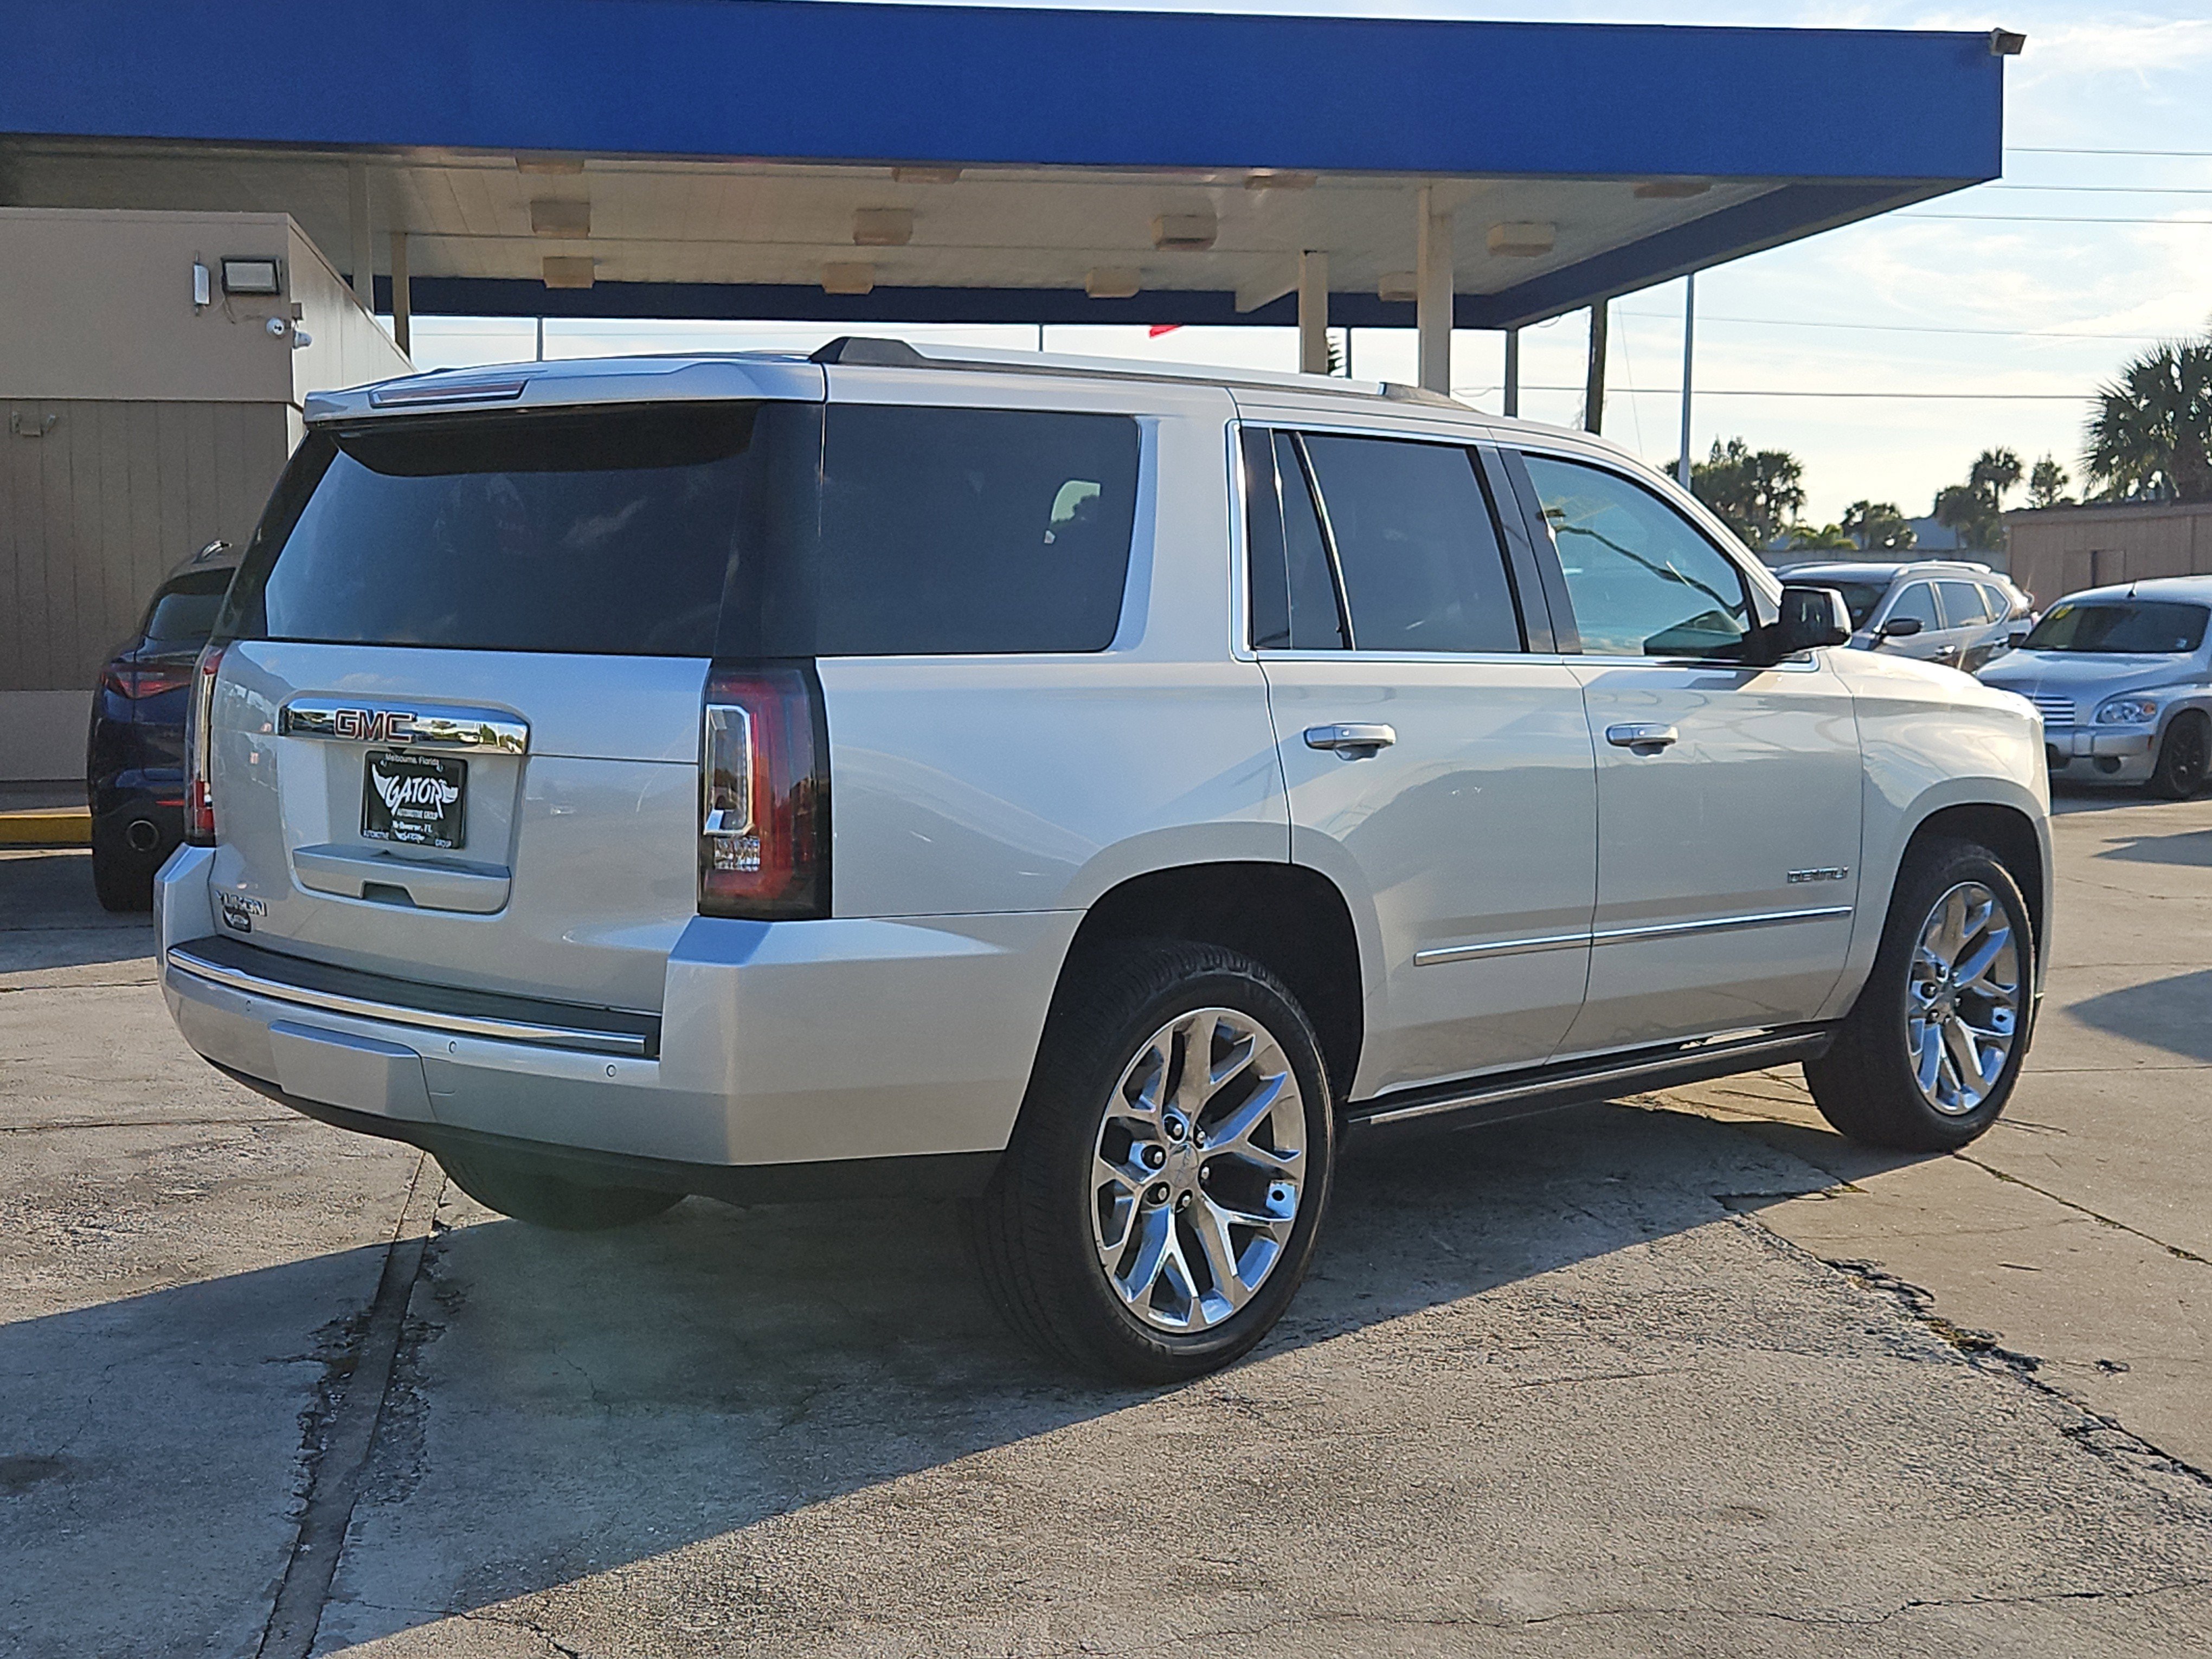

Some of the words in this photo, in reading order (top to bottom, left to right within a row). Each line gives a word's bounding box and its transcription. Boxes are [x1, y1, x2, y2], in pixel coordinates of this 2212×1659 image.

[336, 708, 416, 743] GMC
[385, 776, 444, 819] GATOR
[216, 890, 267, 917] YUKON
